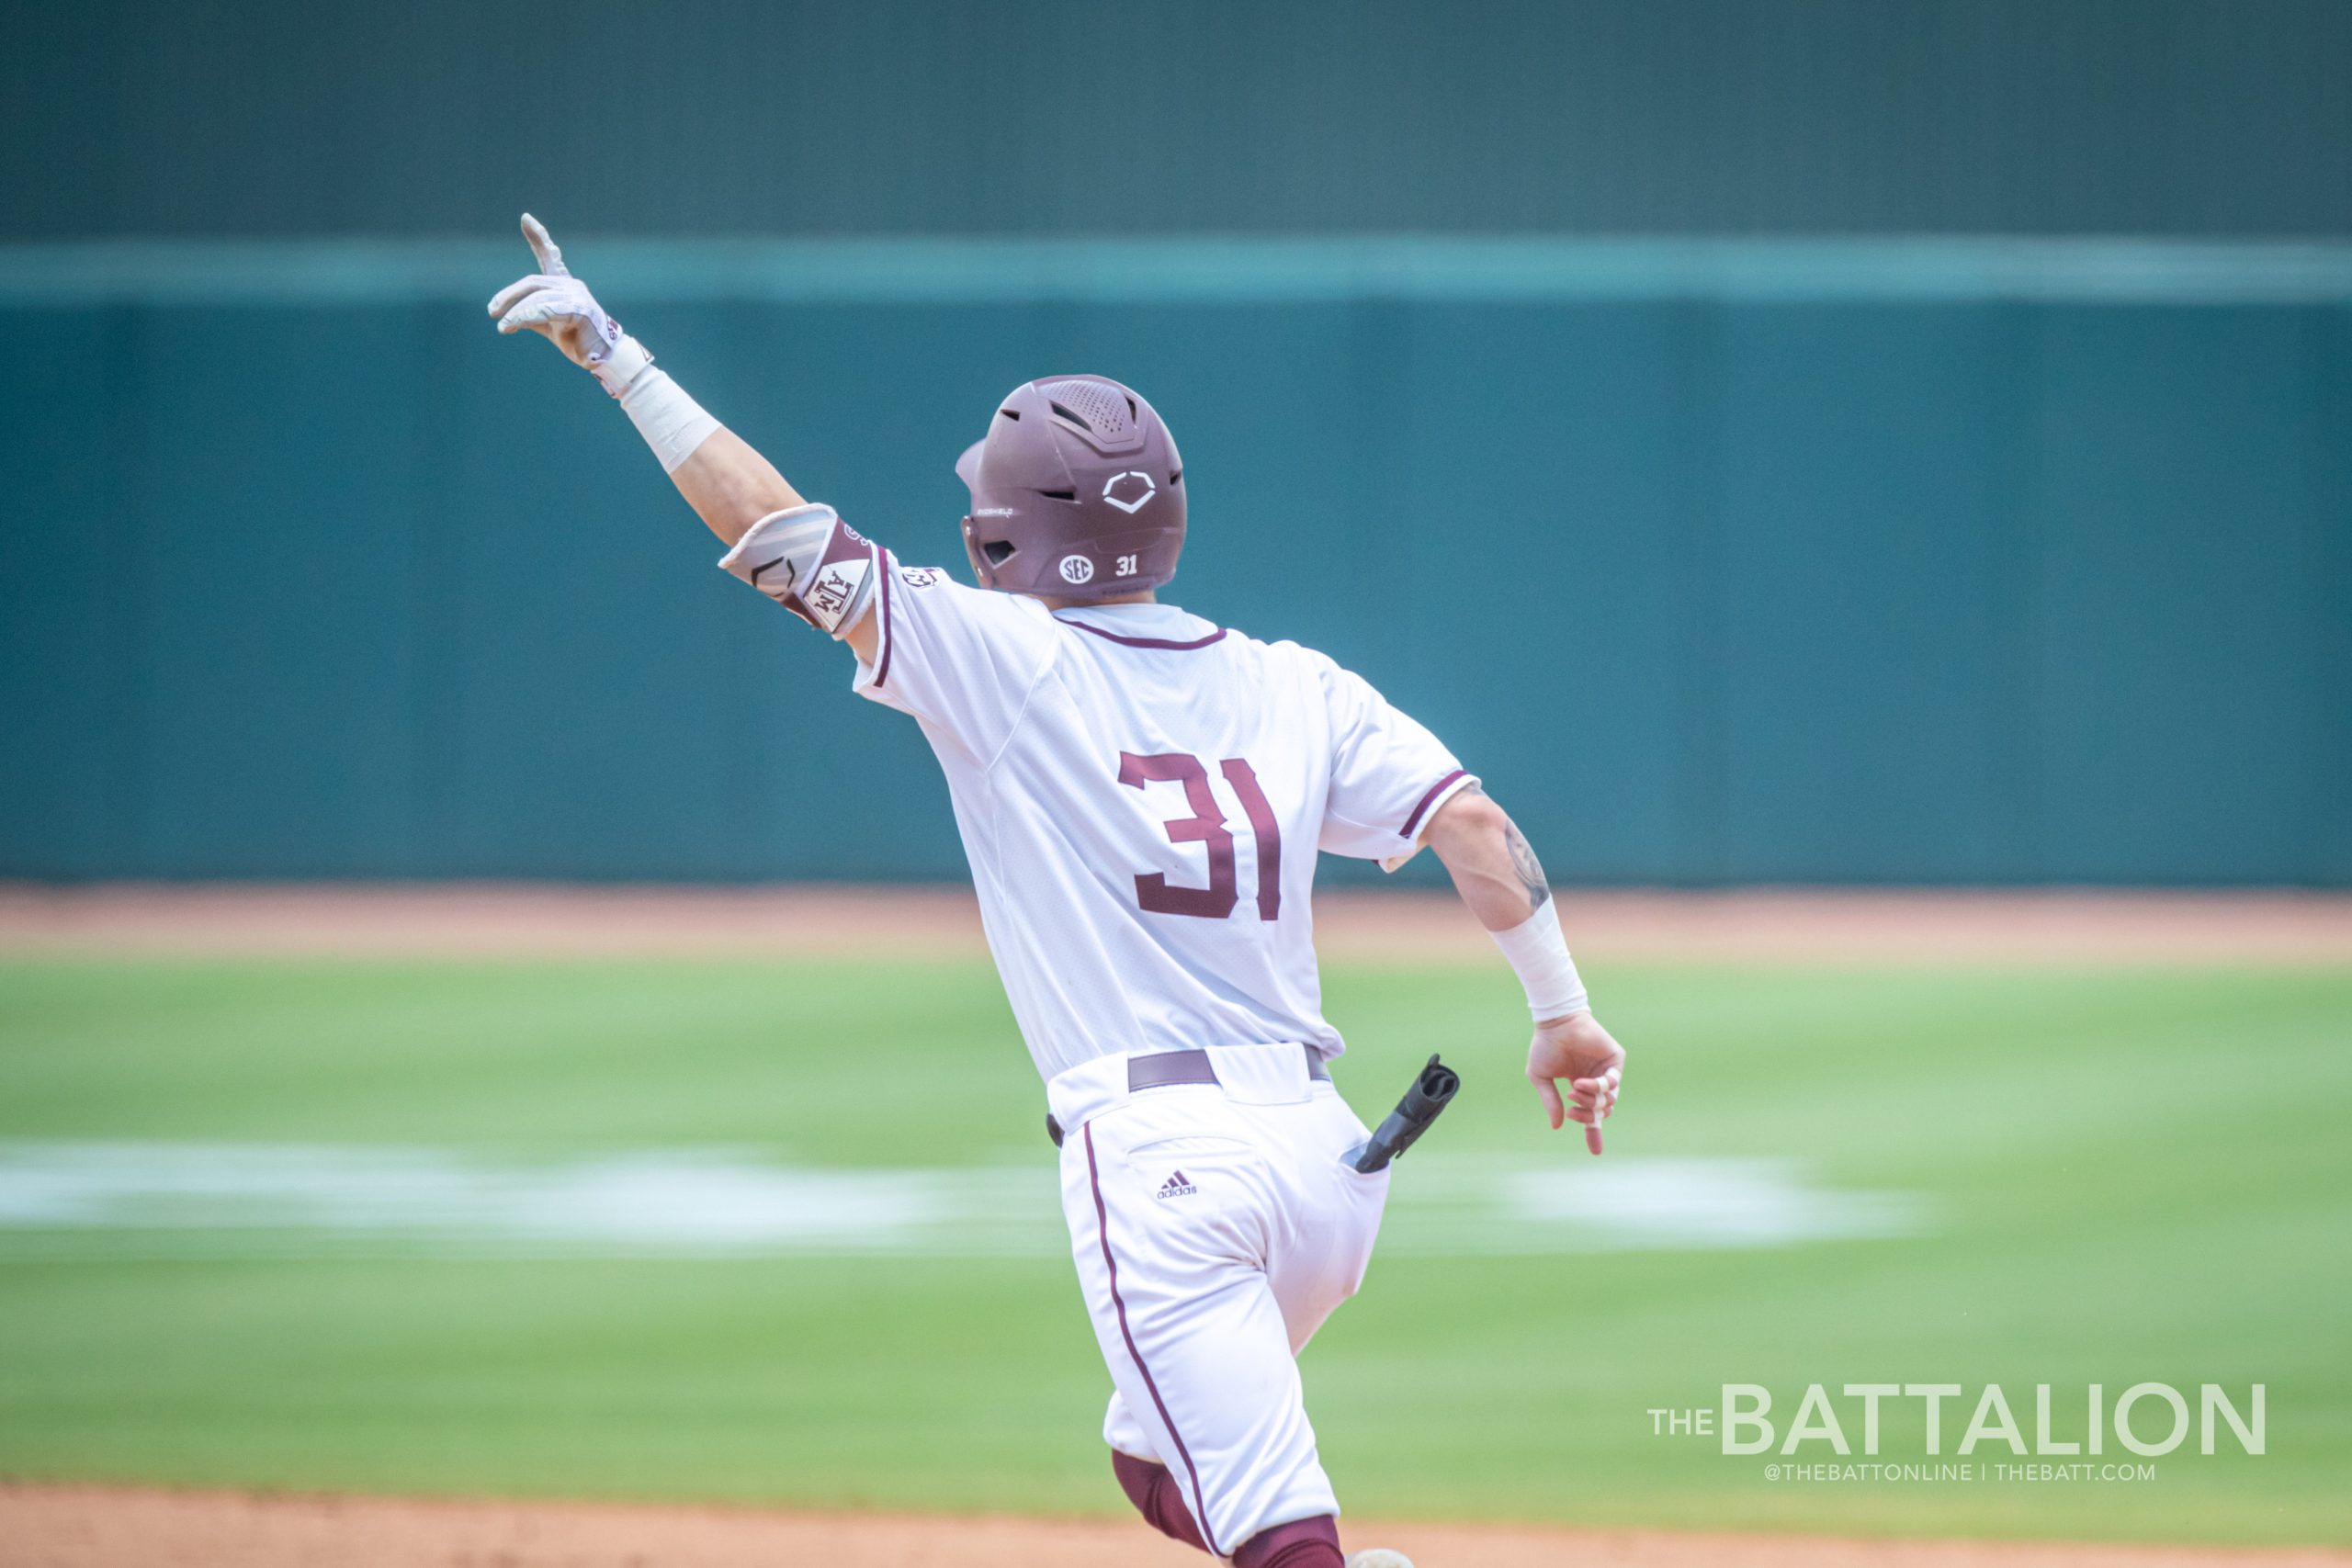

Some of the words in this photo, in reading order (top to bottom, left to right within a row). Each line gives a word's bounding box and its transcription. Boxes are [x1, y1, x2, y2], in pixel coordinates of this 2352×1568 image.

[1064, 558, 1090, 581] SEC
[1114, 554, 1138, 577] 31
[1117, 750, 1282, 921] 31
[1157, 1186, 1197, 1200] adidas
